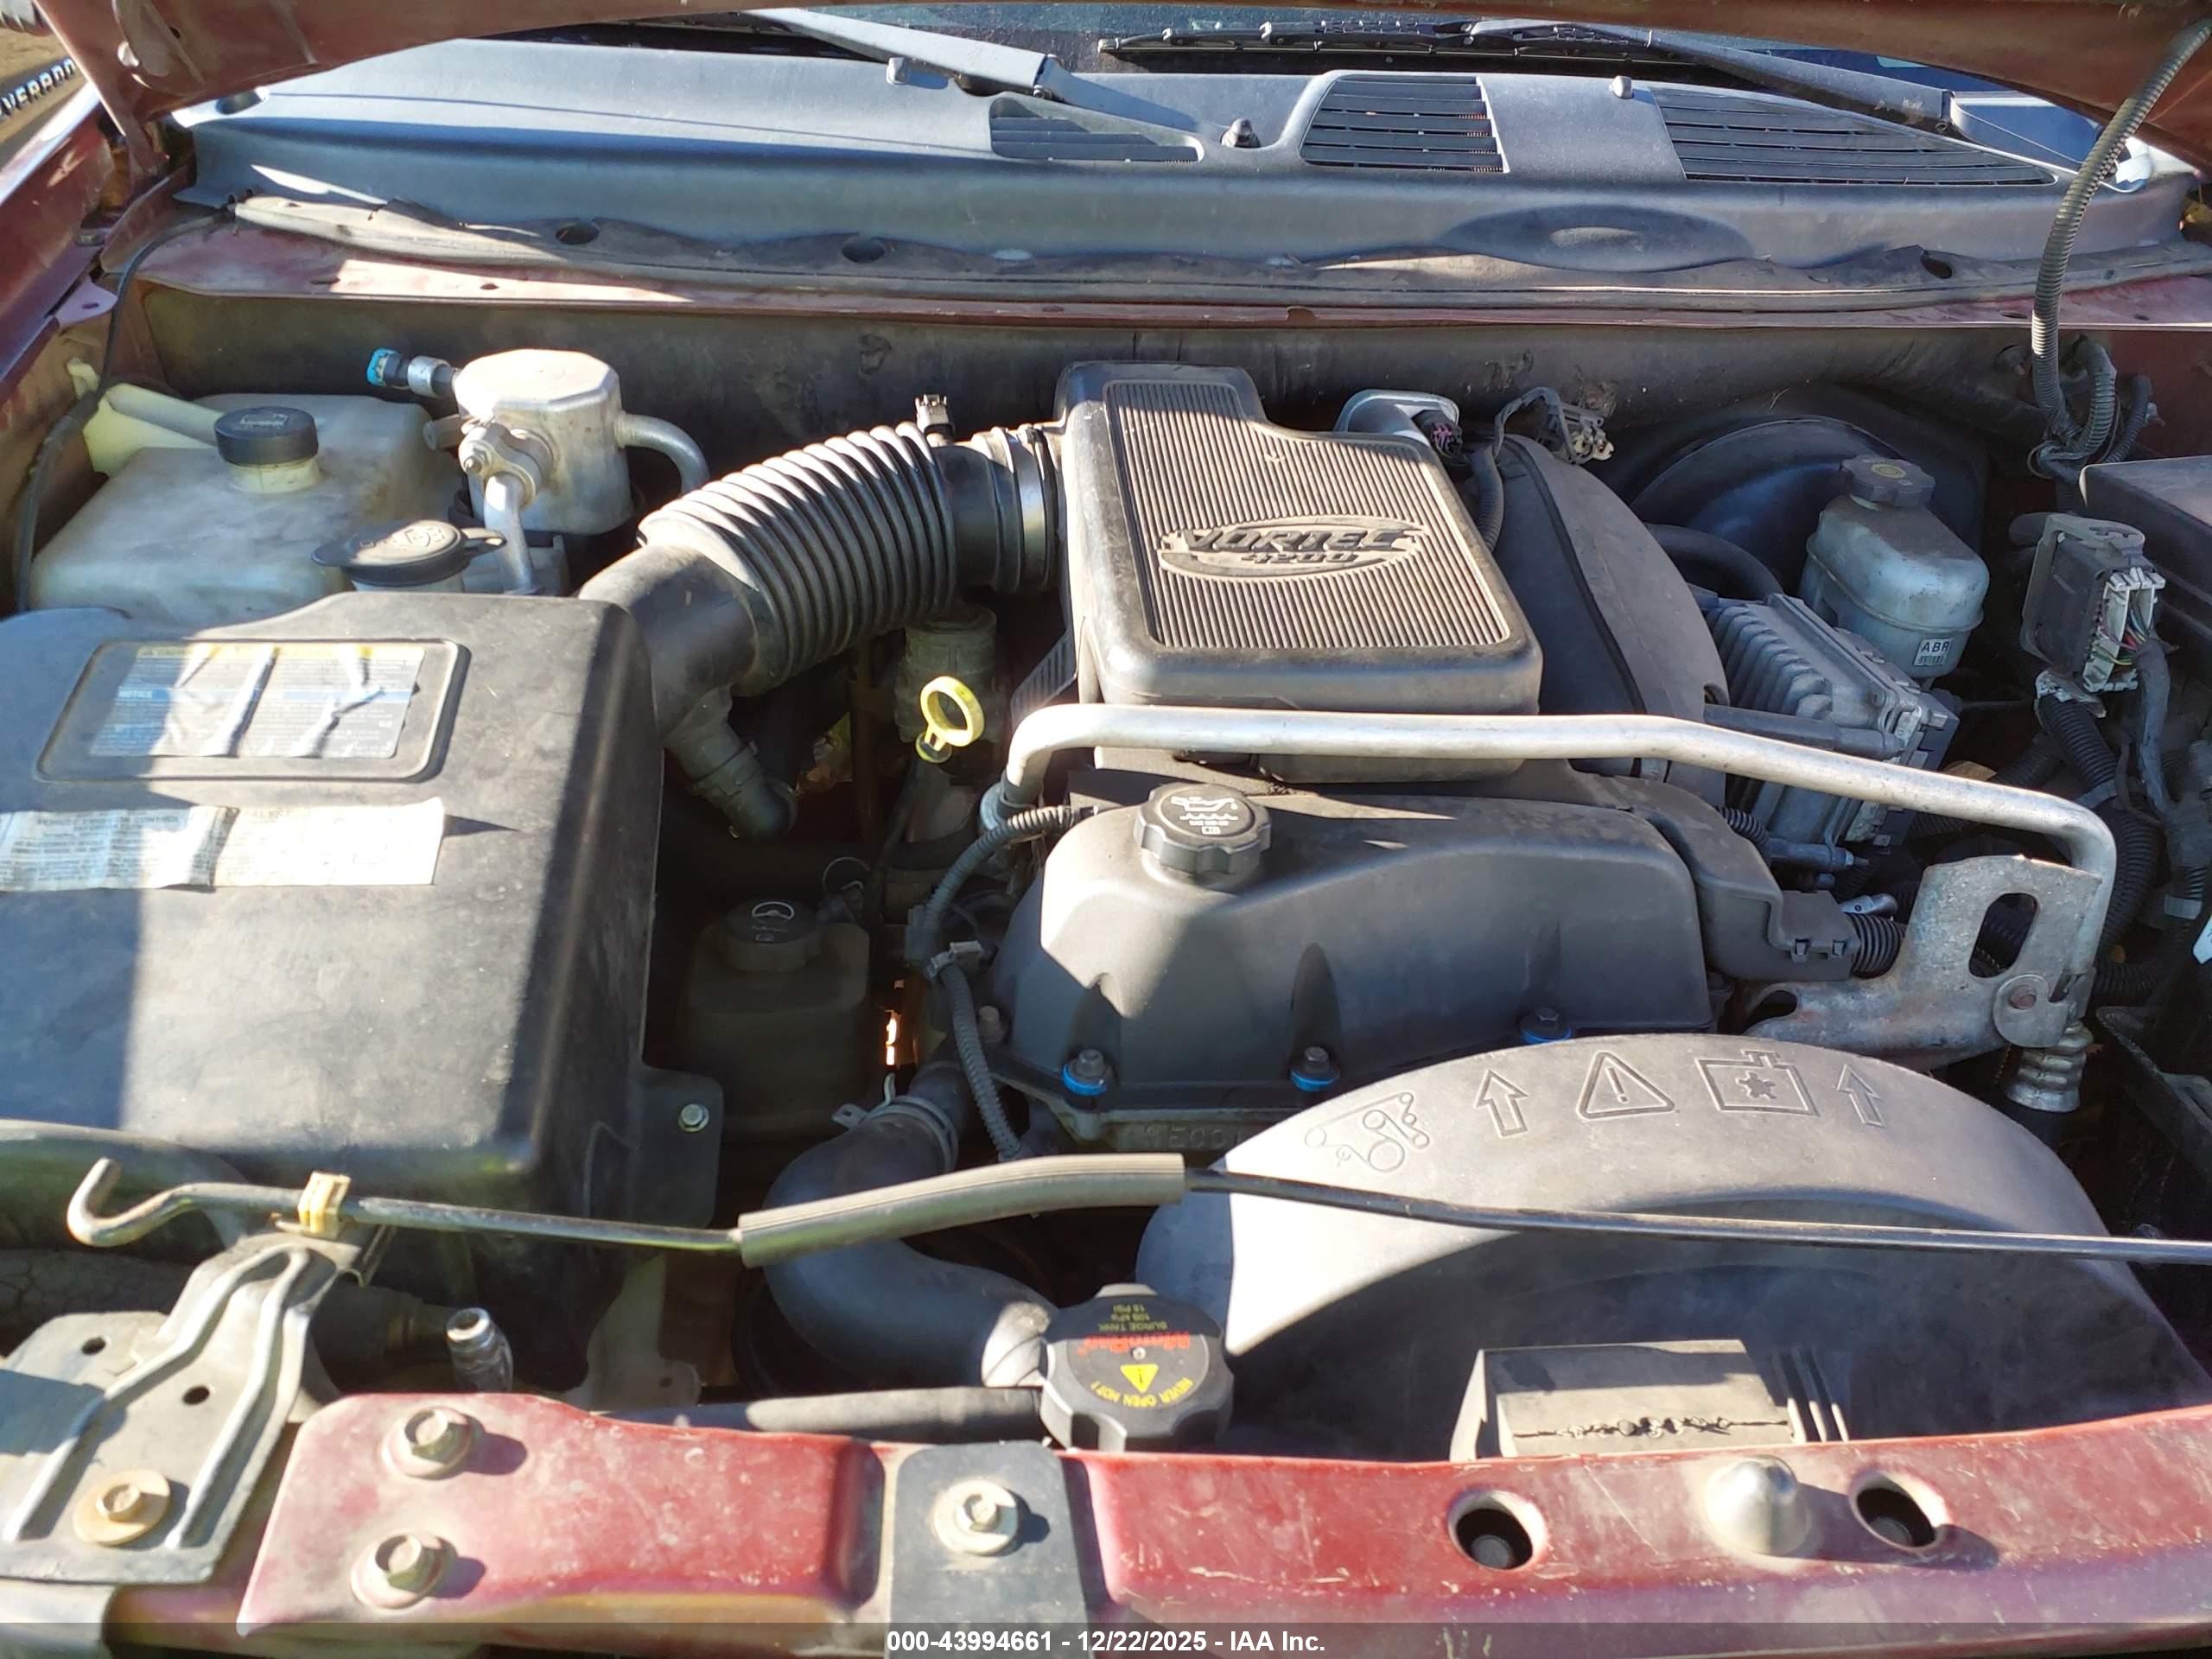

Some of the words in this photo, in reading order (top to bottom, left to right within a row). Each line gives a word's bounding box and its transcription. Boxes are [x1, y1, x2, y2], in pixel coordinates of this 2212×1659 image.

[1183, 529, 1404, 551] VORTEC
[1242, 552, 1357, 564] 4200
[1921, 641, 1950, 652] ABR
[1122, 1394, 1158, 1408] OPEN
